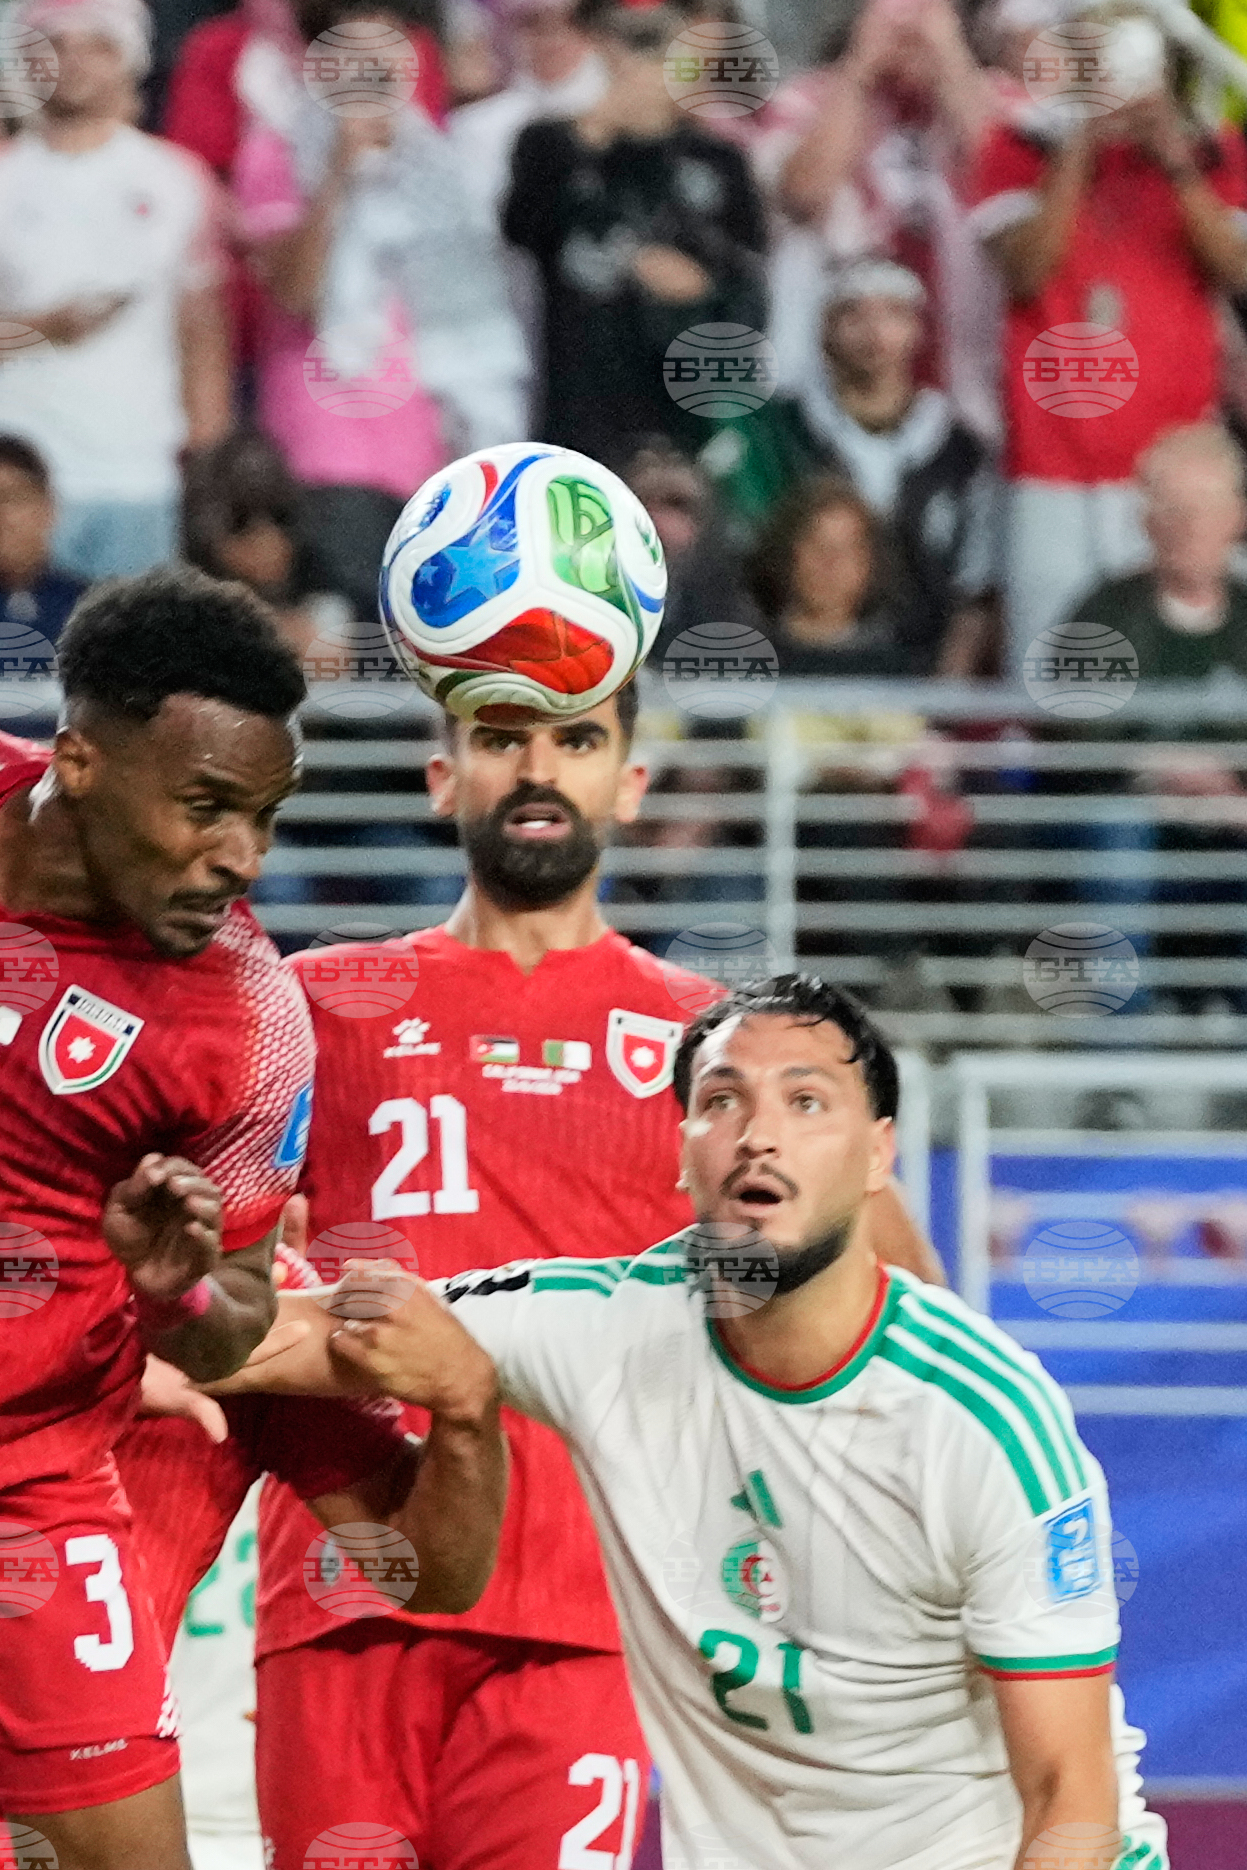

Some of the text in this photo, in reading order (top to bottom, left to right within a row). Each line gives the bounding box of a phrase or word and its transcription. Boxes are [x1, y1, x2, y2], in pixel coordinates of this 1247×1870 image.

[368, 1094, 480, 1222] 21
[65, 1533, 135, 1673] 3
[698, 1629, 814, 1736] 21
